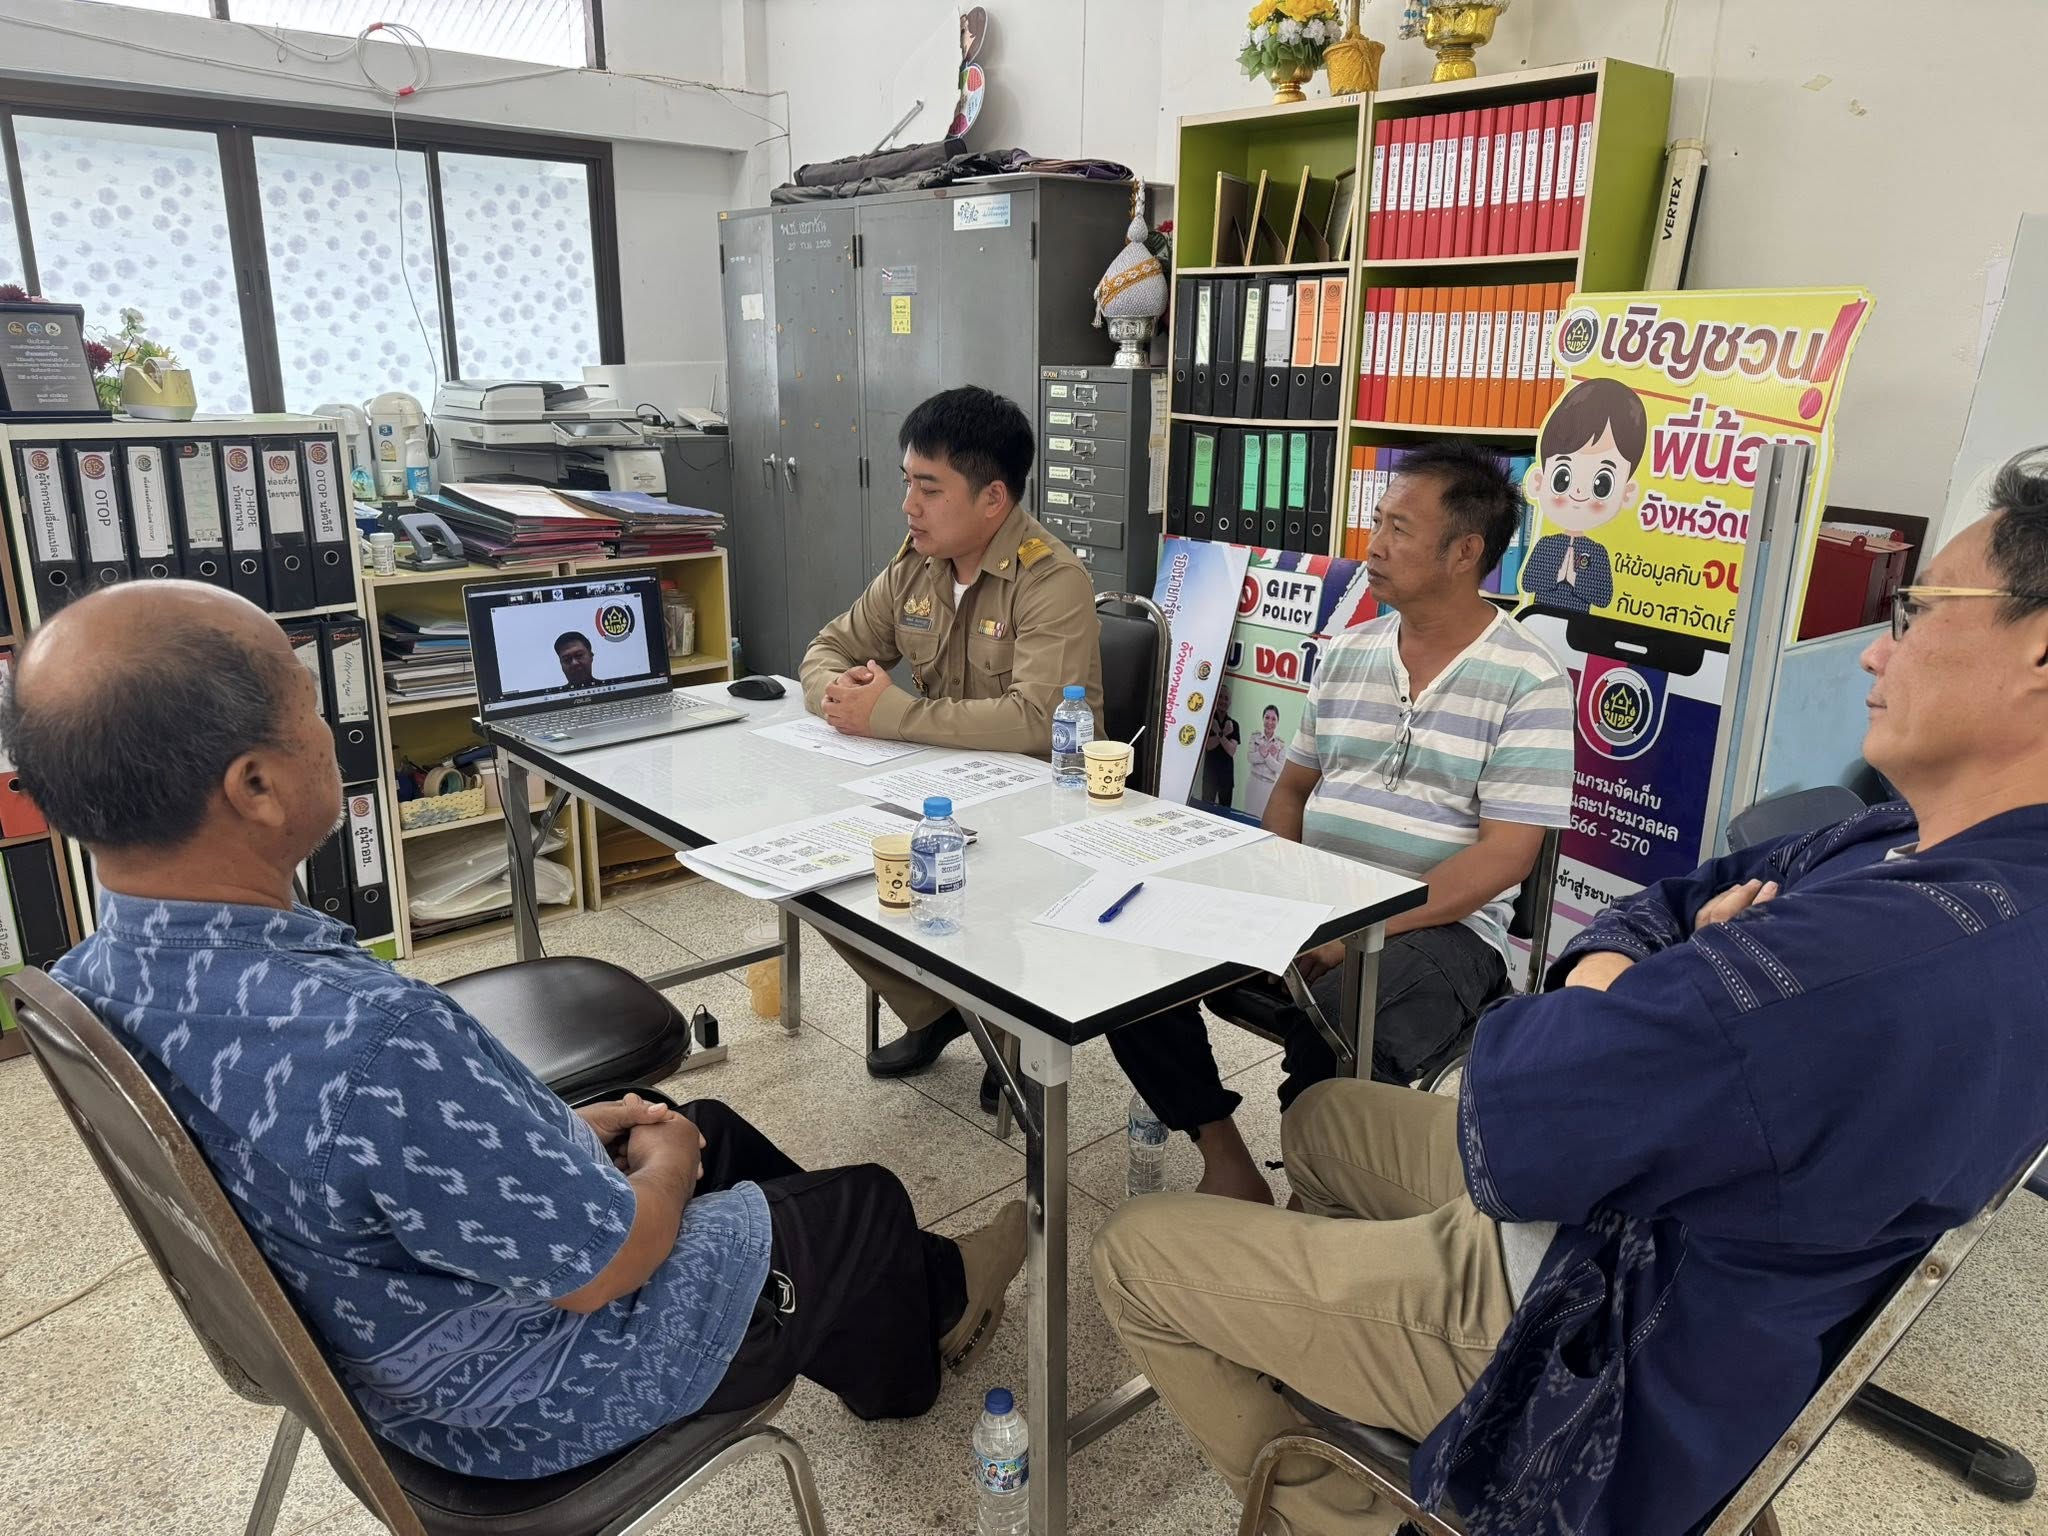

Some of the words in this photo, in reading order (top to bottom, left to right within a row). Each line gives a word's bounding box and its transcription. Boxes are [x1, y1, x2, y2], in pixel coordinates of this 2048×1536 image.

[1662, 177, 1683, 240] VERTEX
[1653, 397, 1811, 484] พี่น้อ
[267, 477, 298, 487] ท่องเที่ยว
[315, 469, 328, 498] OTOP
[94, 489, 112, 527] OTOP
[245, 489, 258, 527] D-HOPE
[1641, 493, 1750, 540] จังหวัดเ
[1266, 579, 1316, 603] GIFT
[1262, 604, 1313, 625] POLICY
[1616, 591, 1737, 634] กับอาสาจัดเก็
[1570, 814, 1598, 837] 566
[1610, 828, 1650, 856] 2570
[1556, 869, 1614, 905] ข้าสู่ระบ
